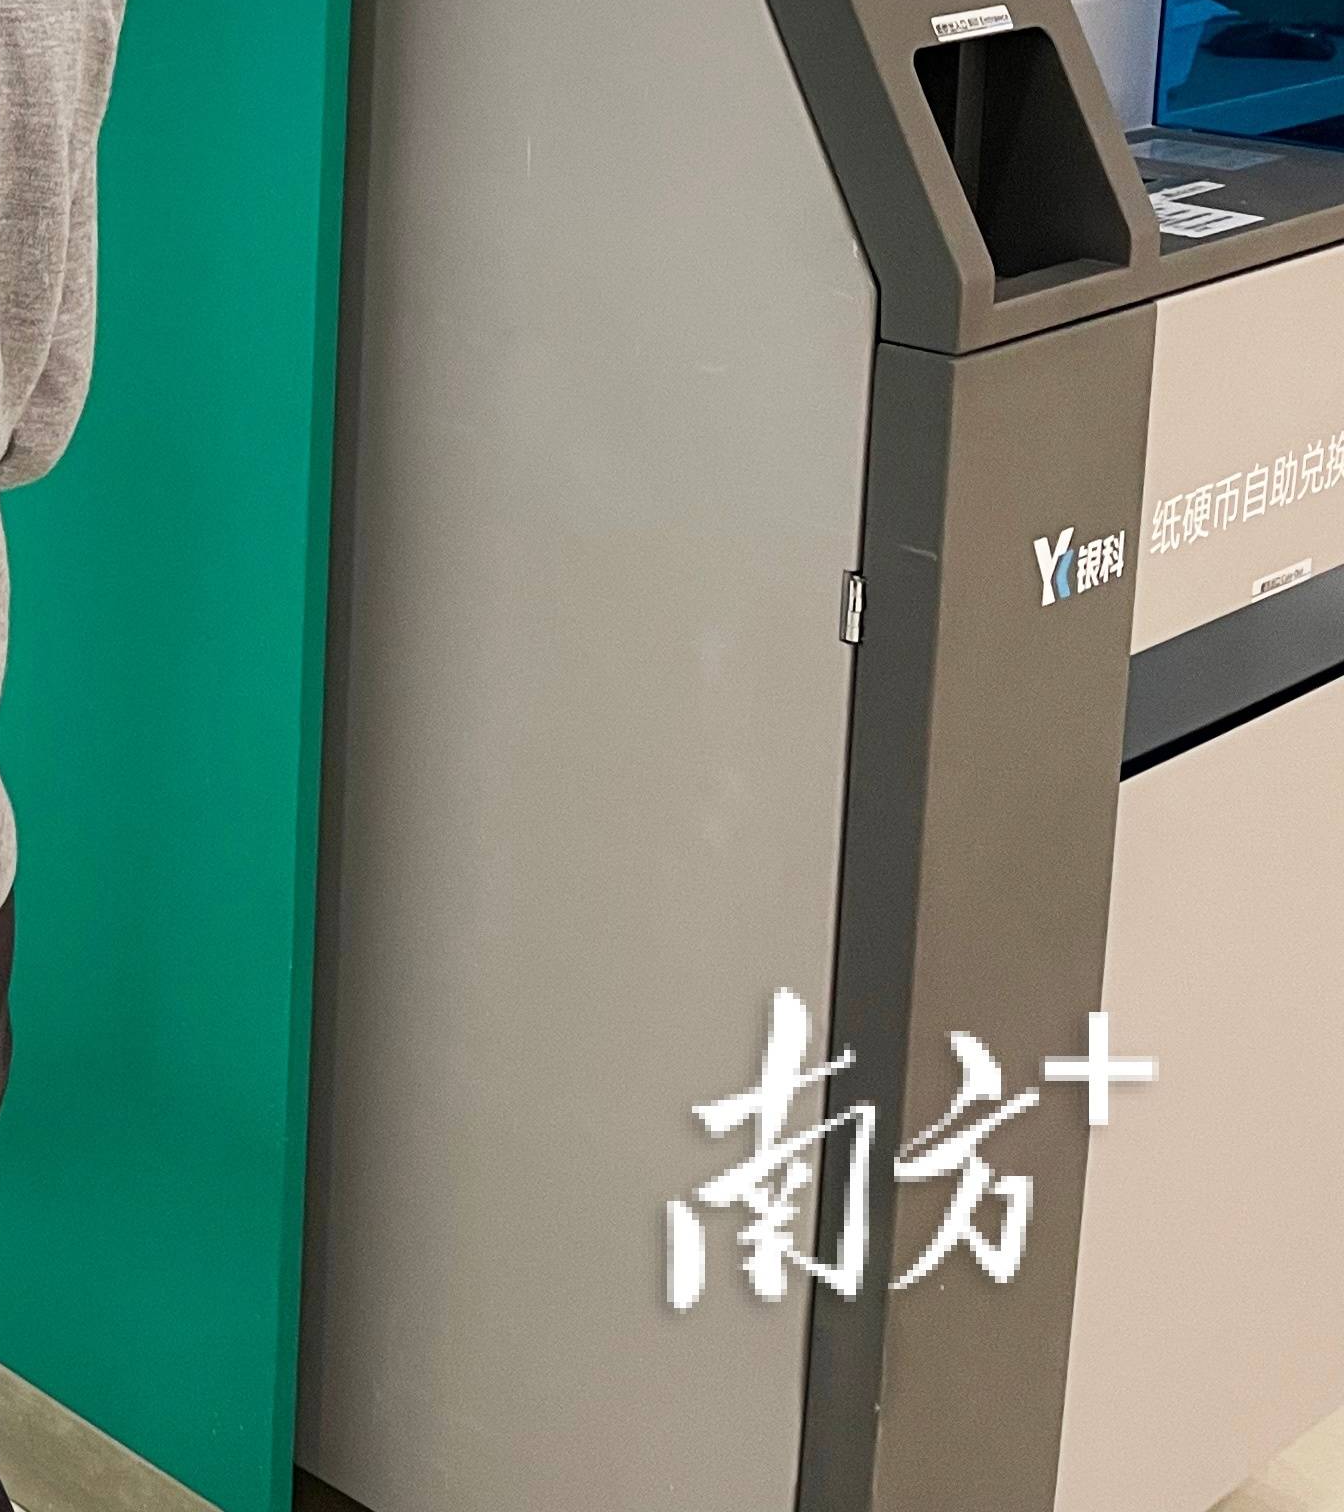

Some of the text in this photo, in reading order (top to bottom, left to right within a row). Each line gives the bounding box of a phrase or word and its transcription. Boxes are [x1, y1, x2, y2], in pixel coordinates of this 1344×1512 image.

[1150, 430, 1344, 555] 纸硬币自助兑换
[1076, 530, 1126, 594] 银科
